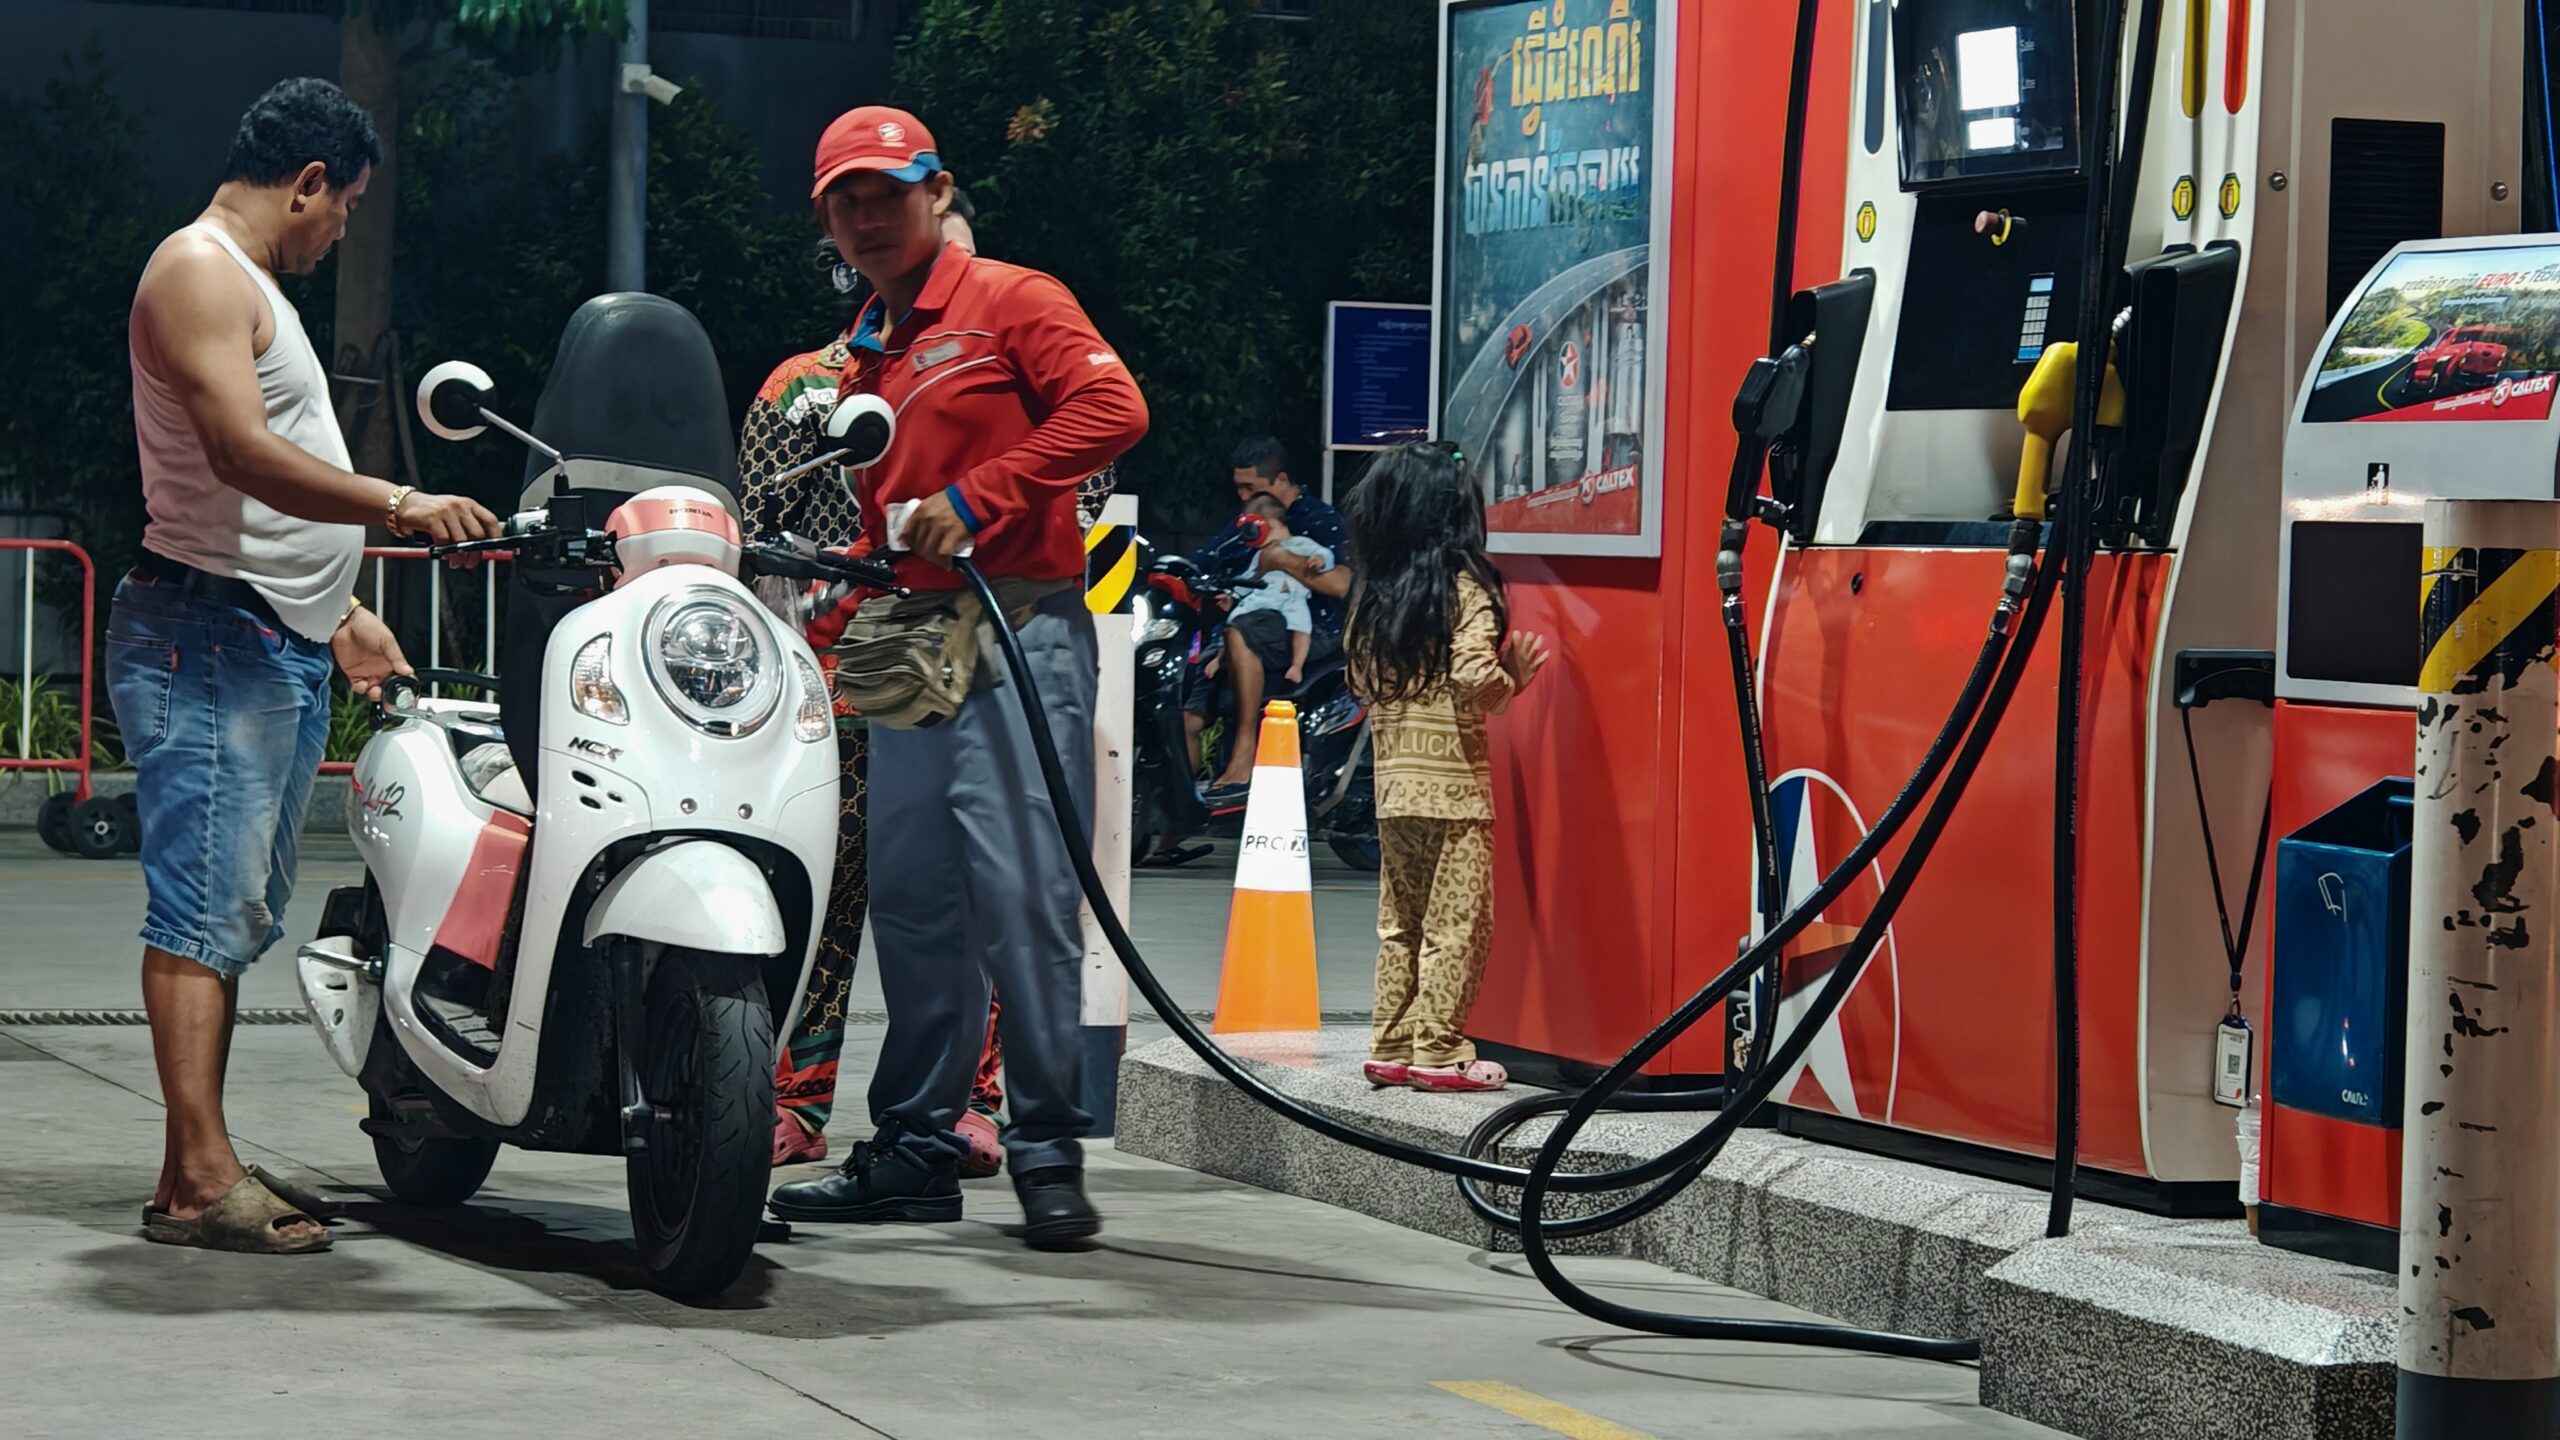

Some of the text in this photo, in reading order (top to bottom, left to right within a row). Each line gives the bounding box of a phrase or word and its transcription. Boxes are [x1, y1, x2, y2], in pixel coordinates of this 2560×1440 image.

[2475, 272, 2517, 289] EURO
[2511, 374, 2553, 397] CALTEX
[1596, 467, 1635, 494] CALTEX
